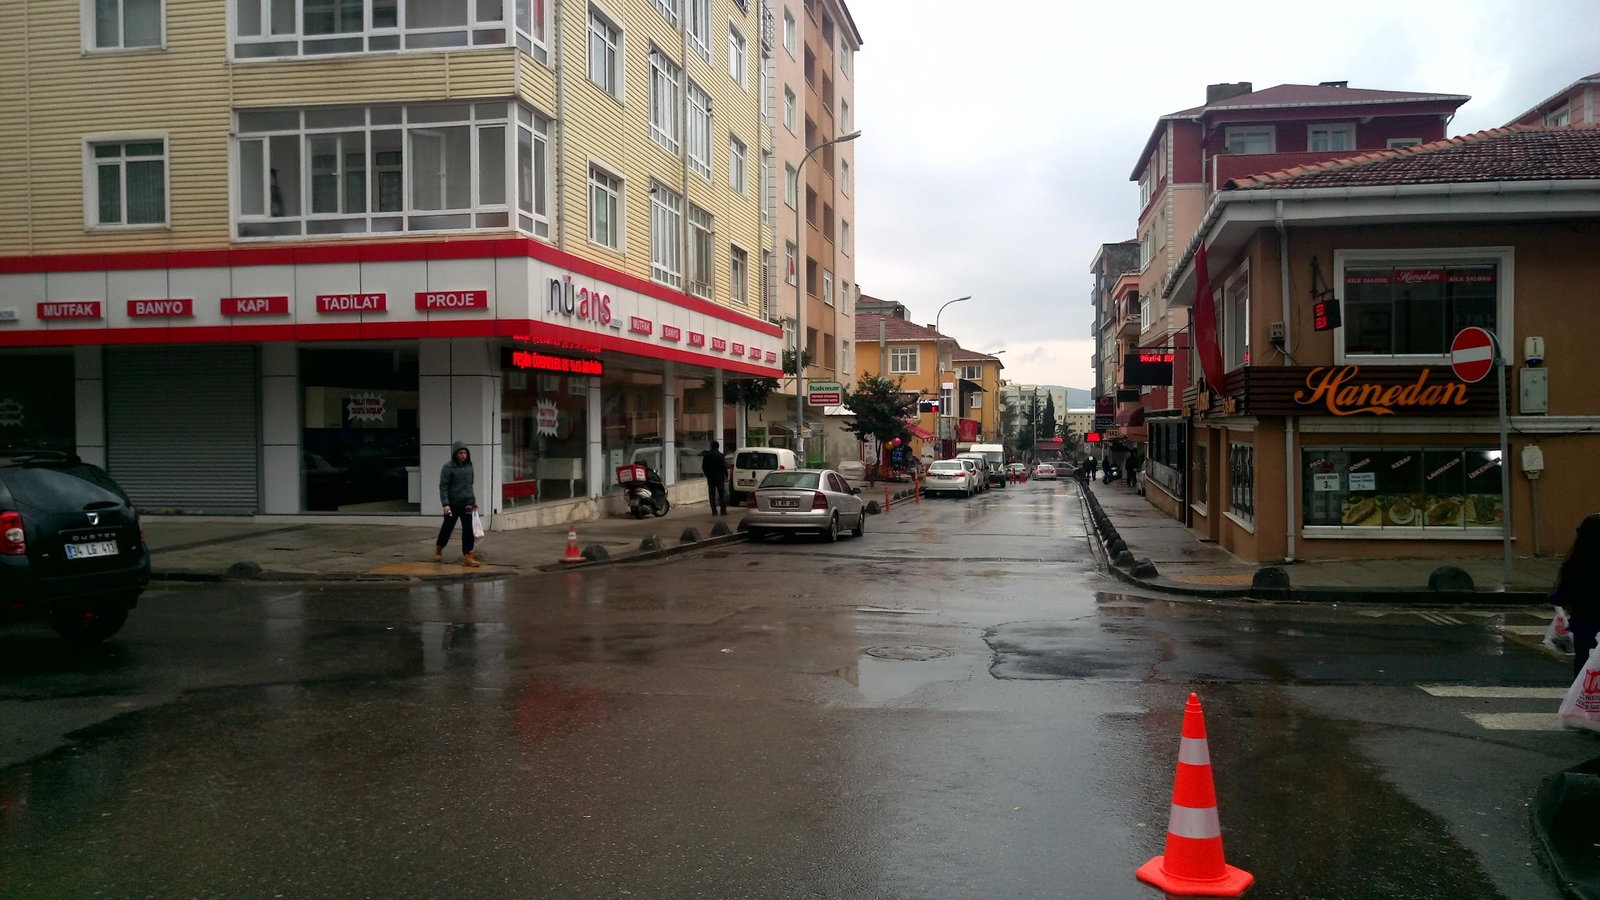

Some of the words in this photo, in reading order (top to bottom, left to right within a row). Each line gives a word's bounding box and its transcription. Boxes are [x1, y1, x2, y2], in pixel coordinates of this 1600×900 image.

[1397, 270, 1440, 284] Hanedan
[237, 300, 269, 312] KAPI
[322, 295, 380, 310] TADİLAT
[426, 293, 475, 307] PROJE
[550, 275, 611, 325] nüans
[43, 303, 94, 316] MUTFAK
[135, 301, 184, 315] BANYO
[632, 318, 652, 333] MUTFAK
[664, 328, 679, 340] BANYO
[692, 334, 702, 345] KAPI
[1293, 365, 1468, 416] Hanedan
[1391, 455, 1412, 469] KEBAP
[1427, 457, 1460, 481] LAHMACUN
[72, 532, 117, 541] DUSTER
